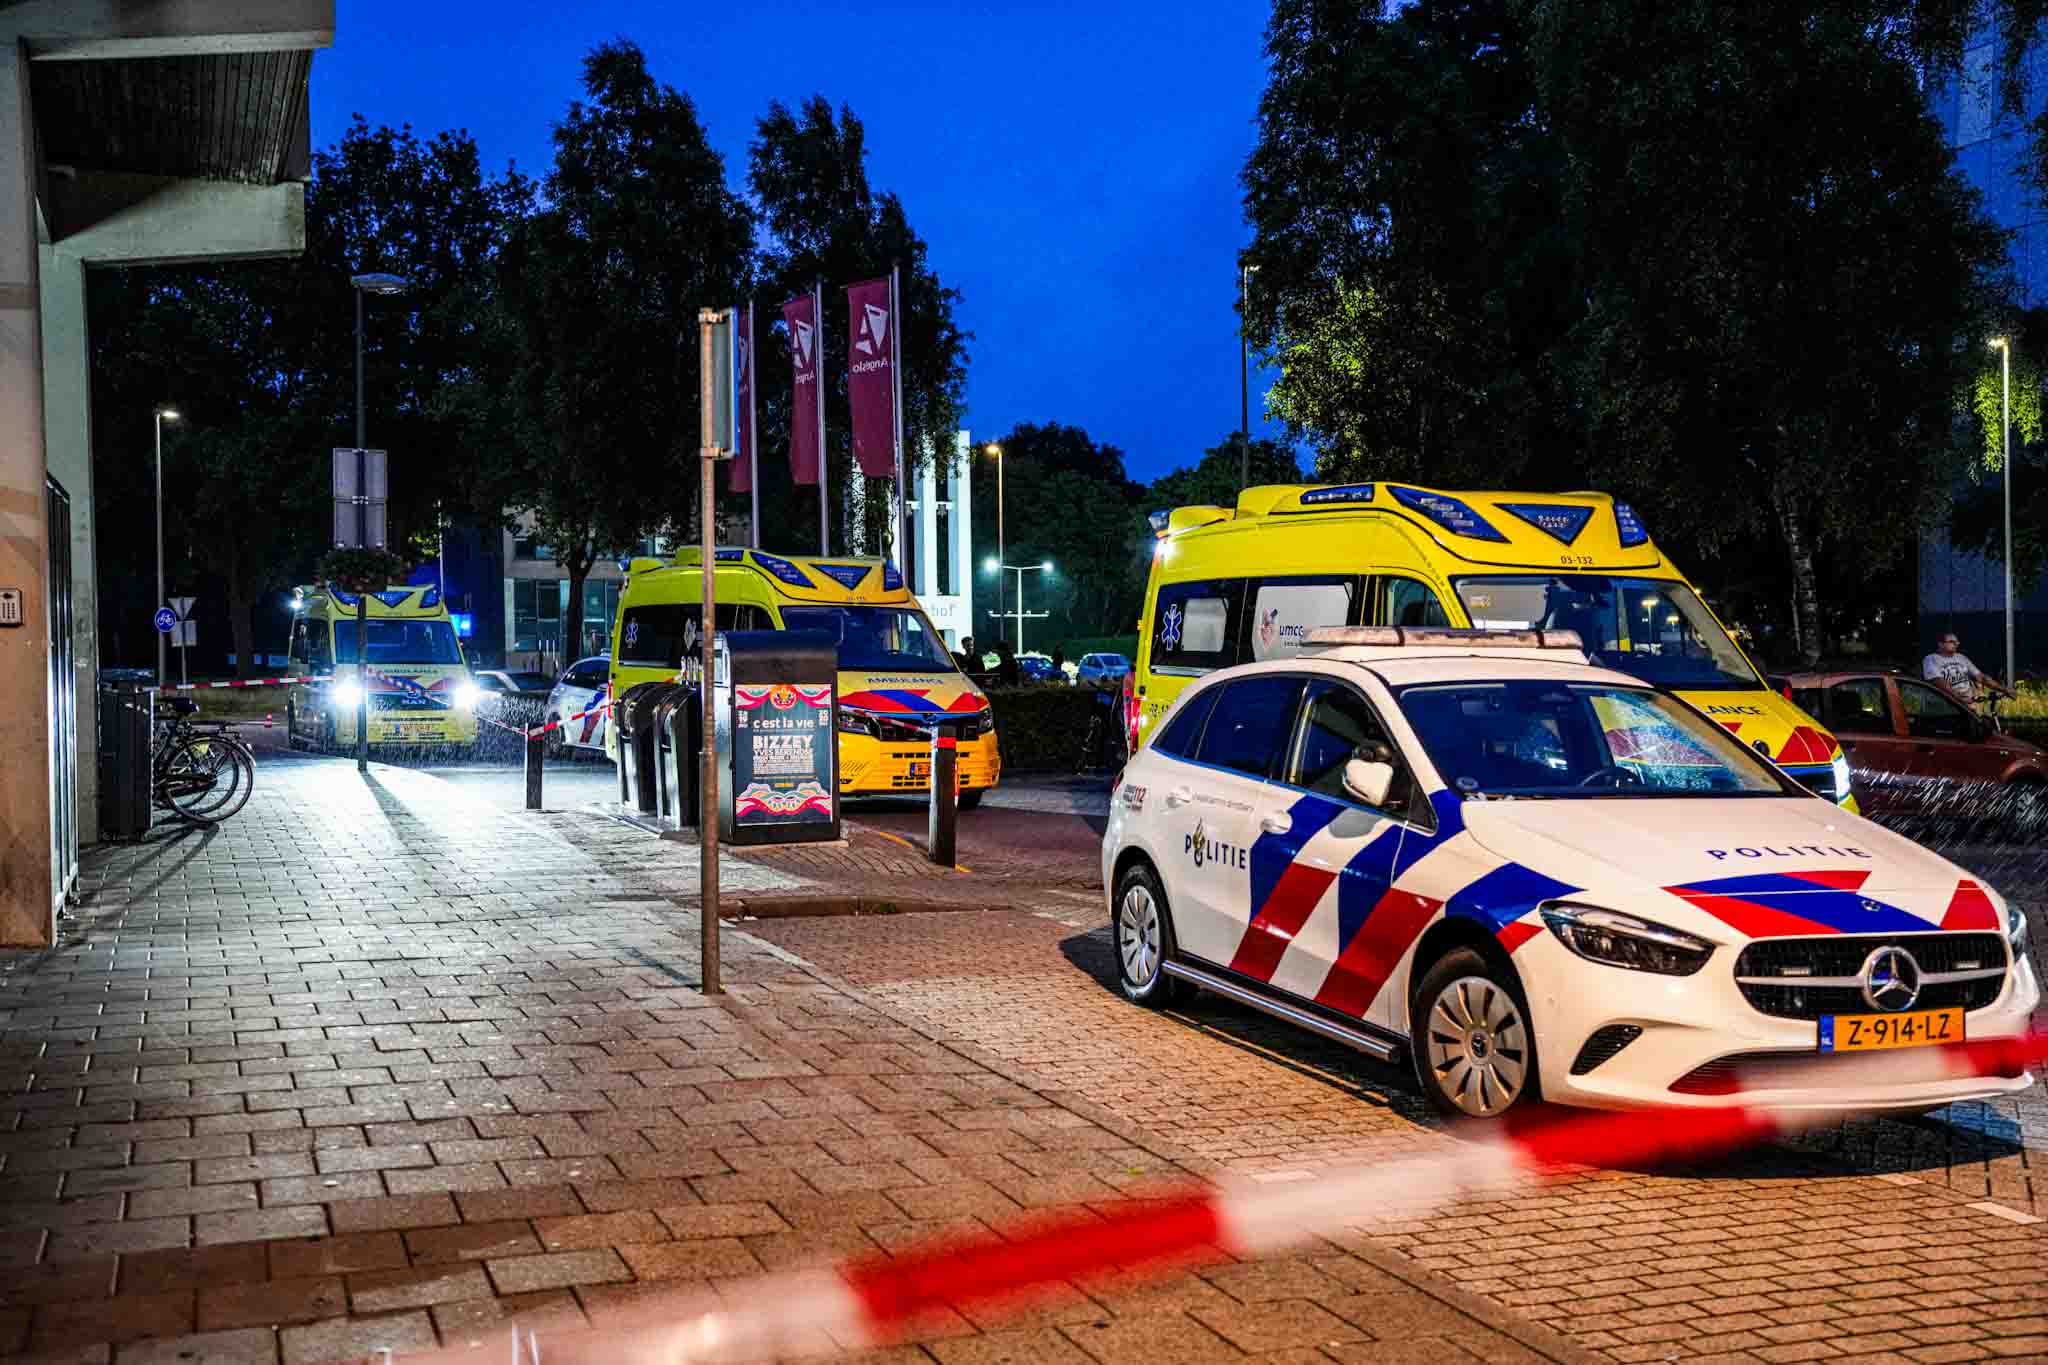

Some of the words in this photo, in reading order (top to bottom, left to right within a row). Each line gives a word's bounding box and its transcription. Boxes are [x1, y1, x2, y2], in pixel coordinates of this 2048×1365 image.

[783, 717, 794, 729] la
[796, 718, 814, 729] vie
[752, 735, 814, 749] BIZZEY
[1184, 833, 1247, 870] POLITIE
[1706, 846, 1873, 860] POLITIE
[1847, 1013, 1951, 1046] Z-914-LZ
